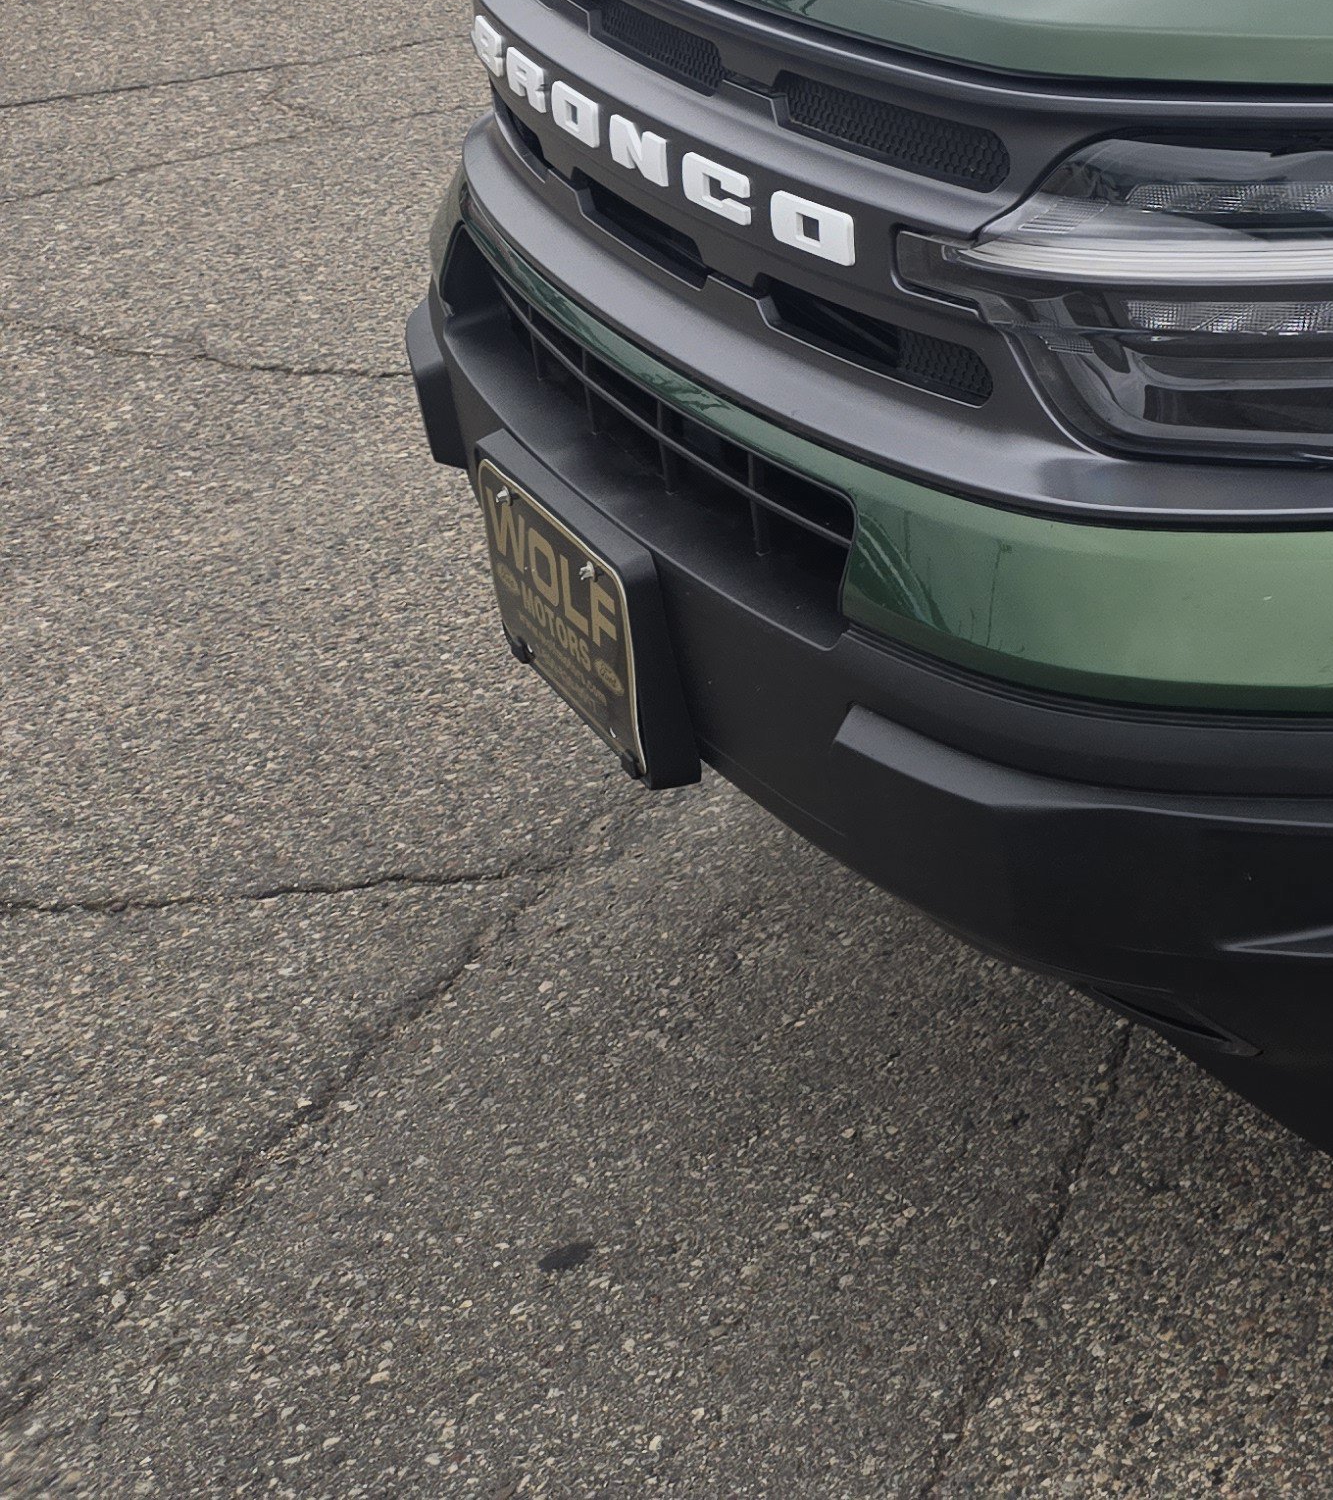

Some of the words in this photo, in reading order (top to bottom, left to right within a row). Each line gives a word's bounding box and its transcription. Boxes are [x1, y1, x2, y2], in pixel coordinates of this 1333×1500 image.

[471, 14, 856, 267] BRONCO
[485, 485, 618, 648] WOLF
[520, 580, 592, 672] MOTORS
